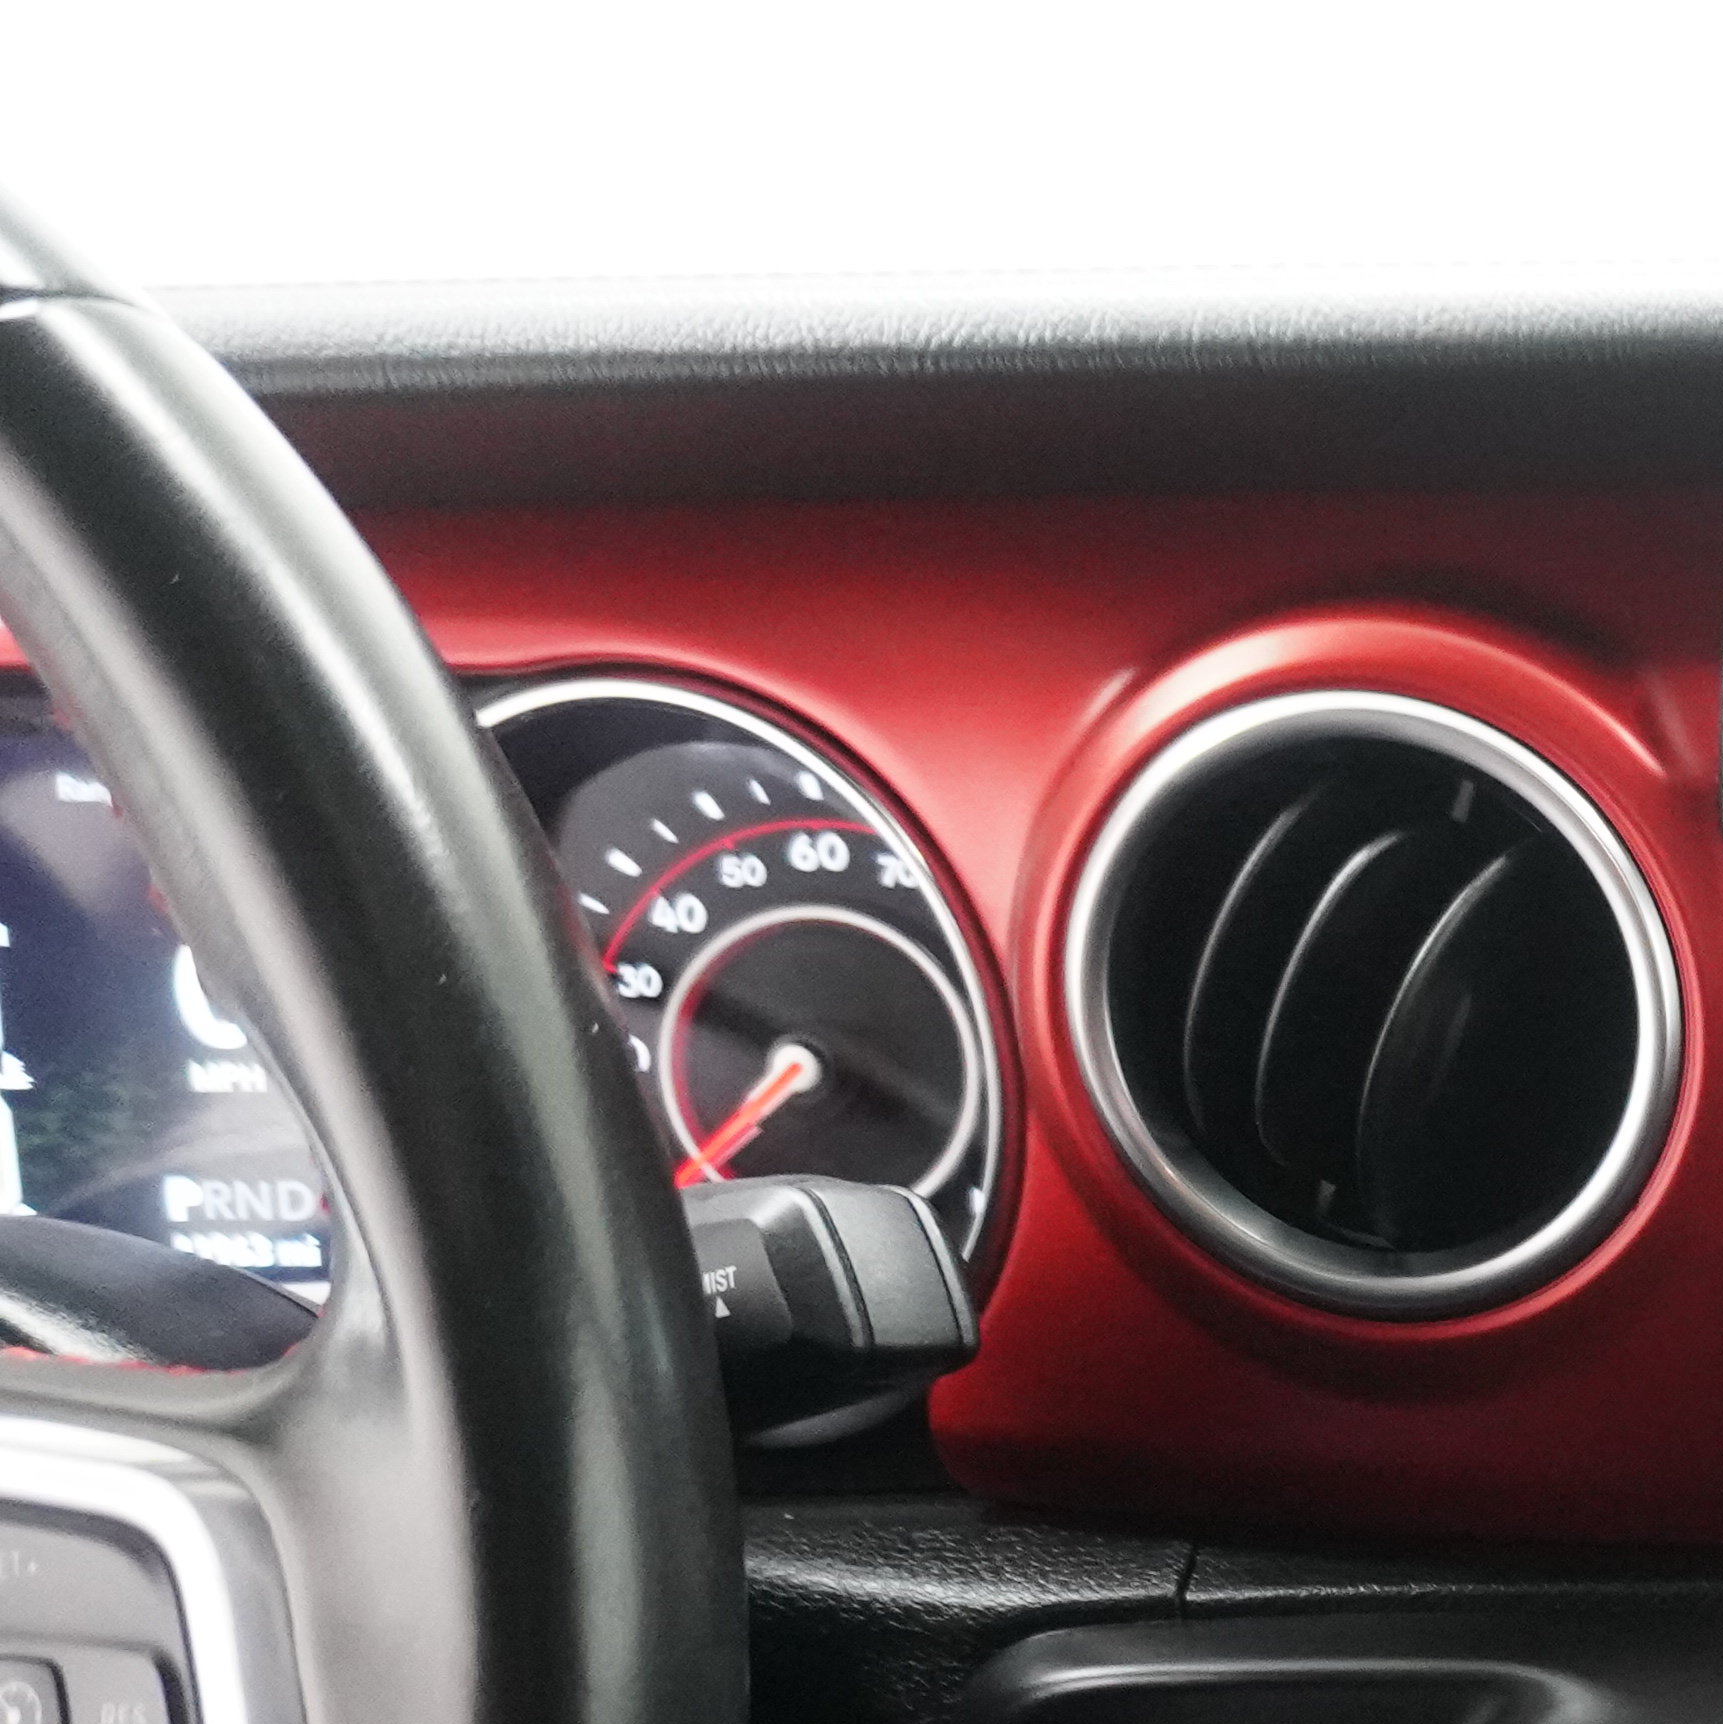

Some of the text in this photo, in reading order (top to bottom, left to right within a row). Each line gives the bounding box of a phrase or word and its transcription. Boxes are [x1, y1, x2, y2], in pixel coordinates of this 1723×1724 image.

[788, 841, 850, 872] 60
[719, 858, 768, 888] 50
[649, 896, 708, 932] 40
[619, 966, 661, 998] 30
[186, 1063, 267, 1093] MPH
